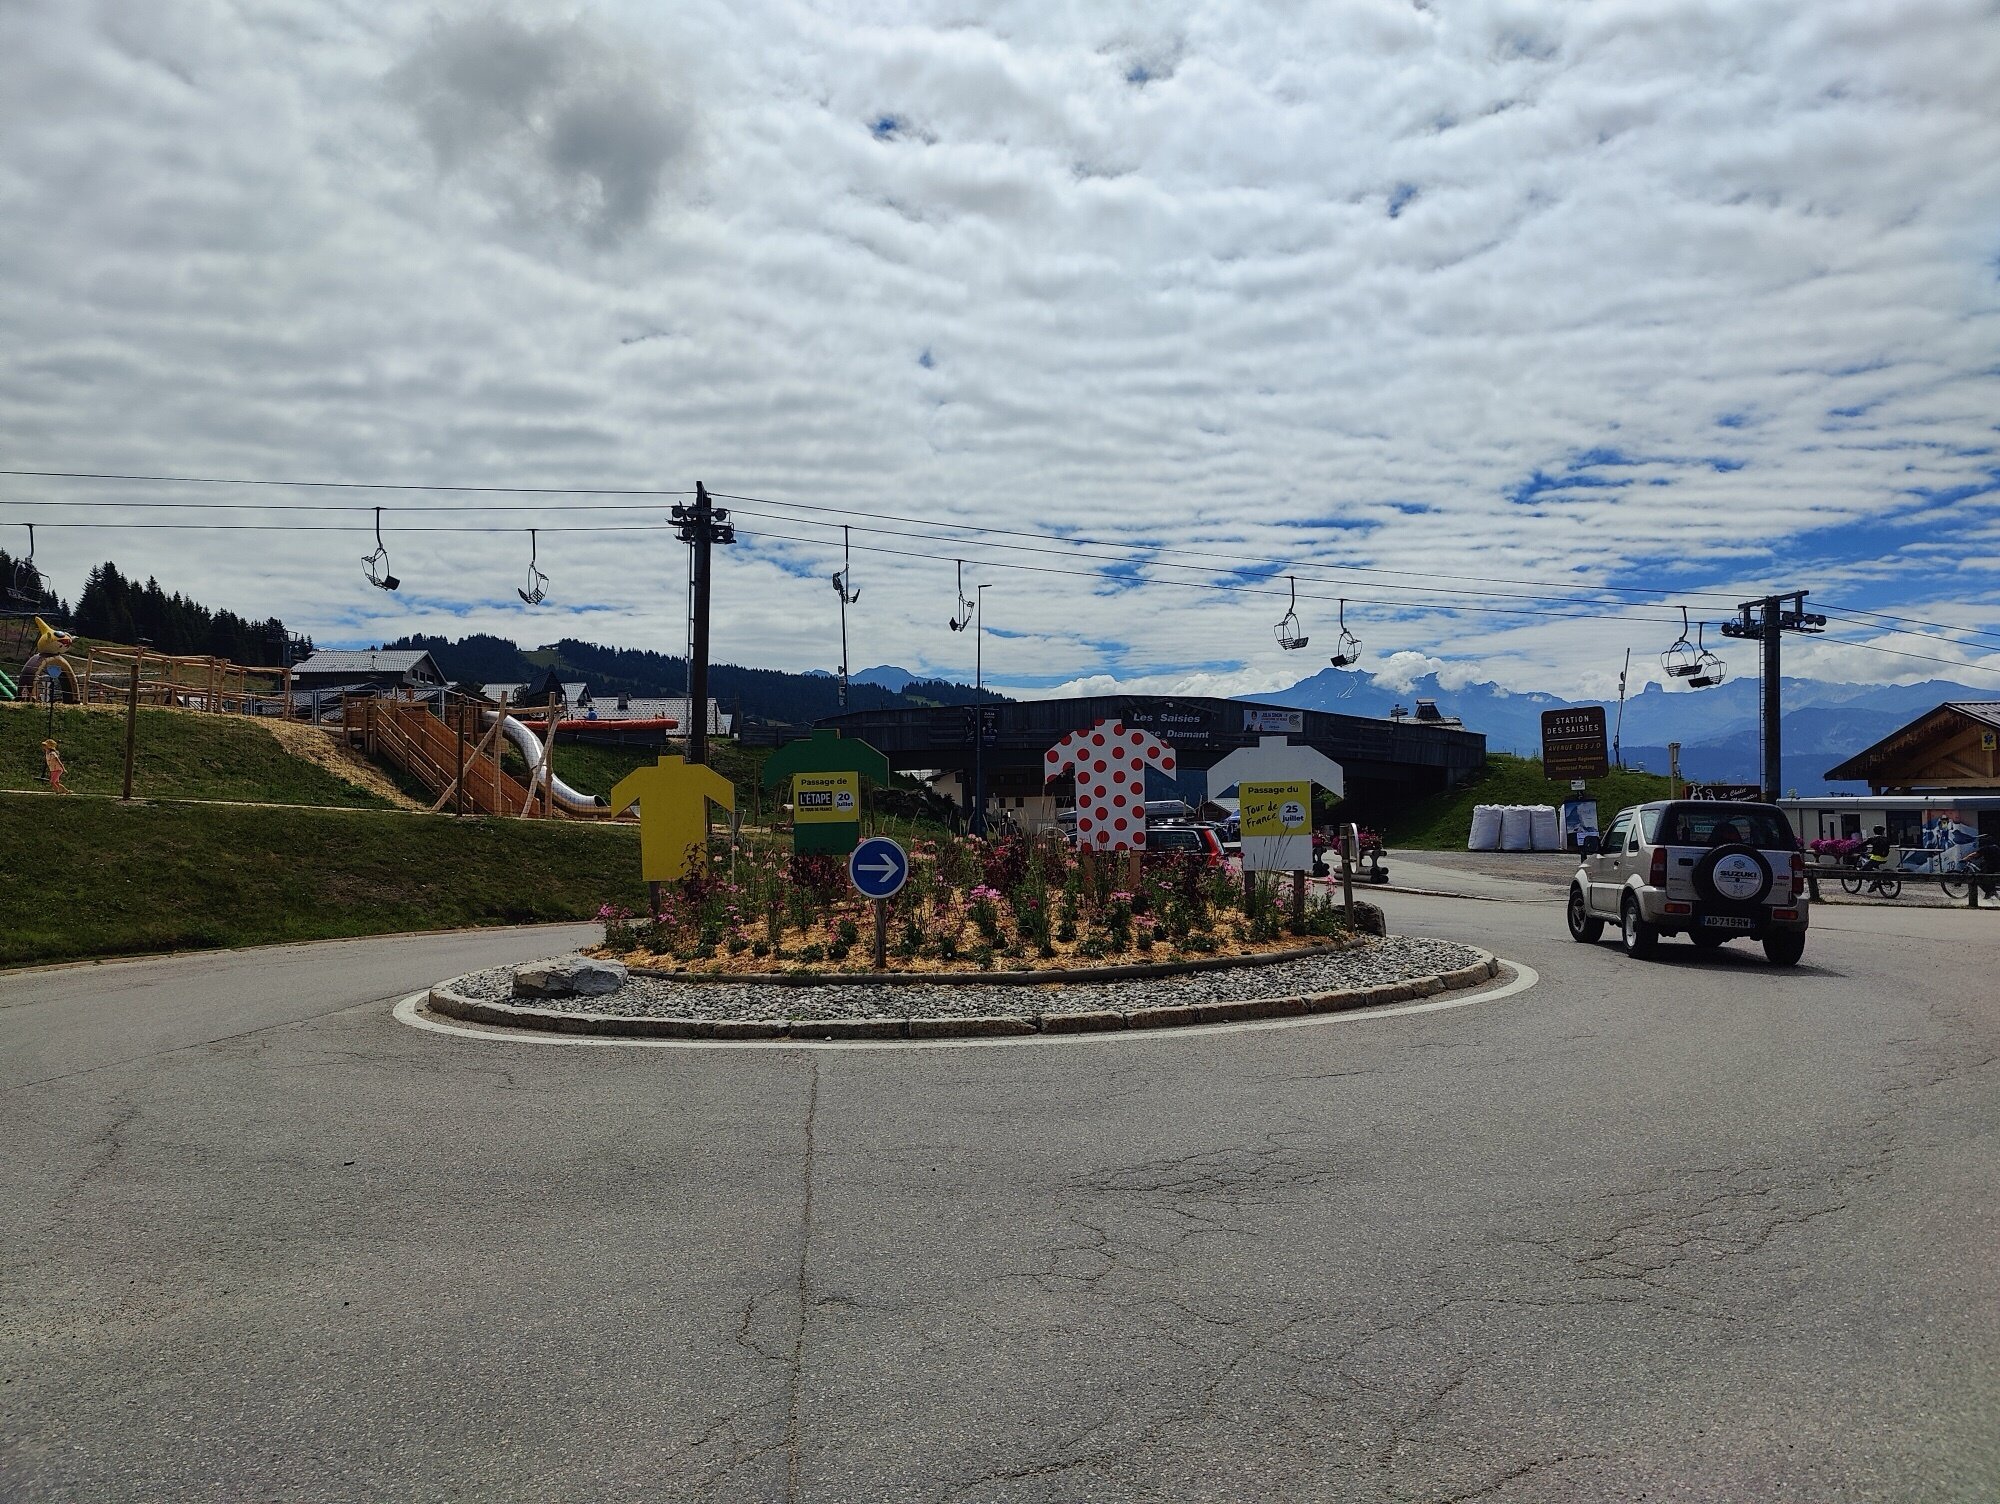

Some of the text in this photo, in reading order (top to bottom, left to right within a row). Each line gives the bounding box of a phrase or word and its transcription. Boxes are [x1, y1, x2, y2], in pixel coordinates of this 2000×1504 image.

[1133, 712, 1201, 723] Les Saisies
[1556, 716, 1589, 724] STATION
[1566, 724, 1599, 733] SAISIES
[1167, 729, 1210, 739] Diamant
[1248, 785, 1299, 795] Passage du
[800, 792, 831, 805] L'ÉTAPE
[1244, 801, 1278, 816] Tour de
[1285, 805, 1298, 813] 25
[1246, 813, 1277, 829] France
[1282, 814, 1305, 823] juillet
[1719, 870, 1757, 878] SUZUKI
